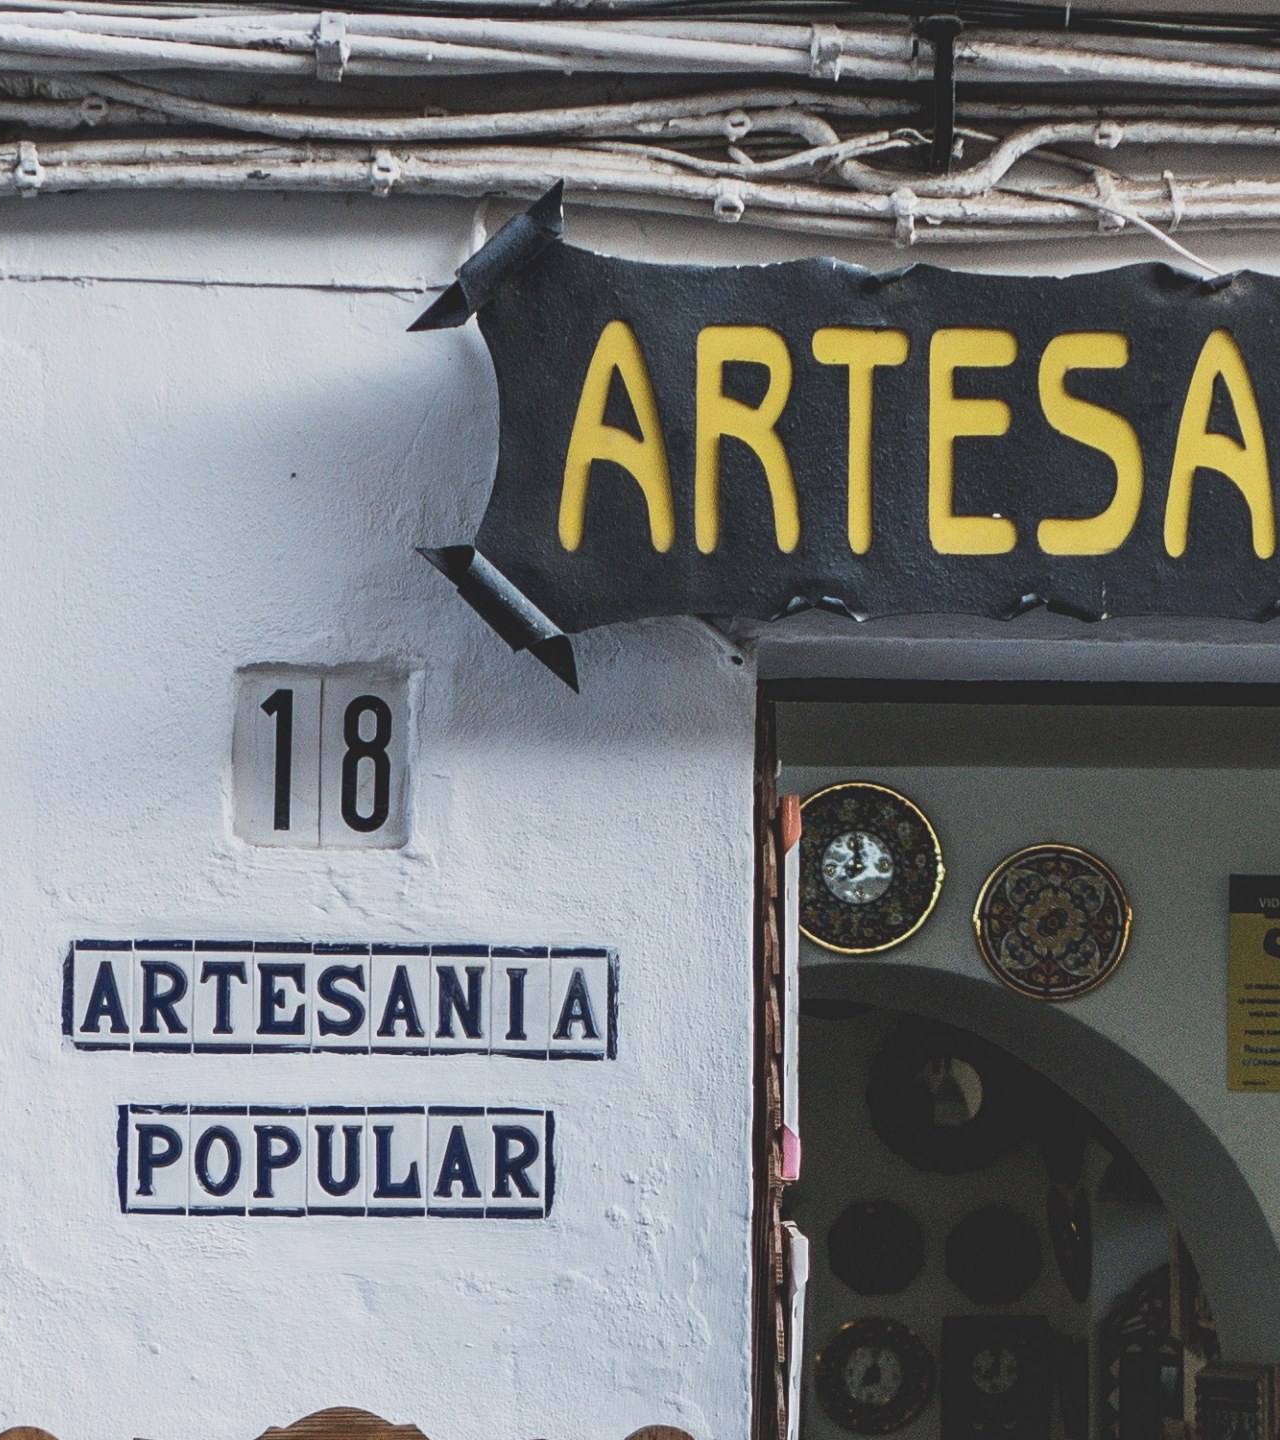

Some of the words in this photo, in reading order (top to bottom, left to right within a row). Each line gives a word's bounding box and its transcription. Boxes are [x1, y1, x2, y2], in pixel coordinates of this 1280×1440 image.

[260, 688, 393, 833] 18
[79, 958, 600, 1042] ARTESANIA
[134, 1122, 541, 1200] POPULAR
